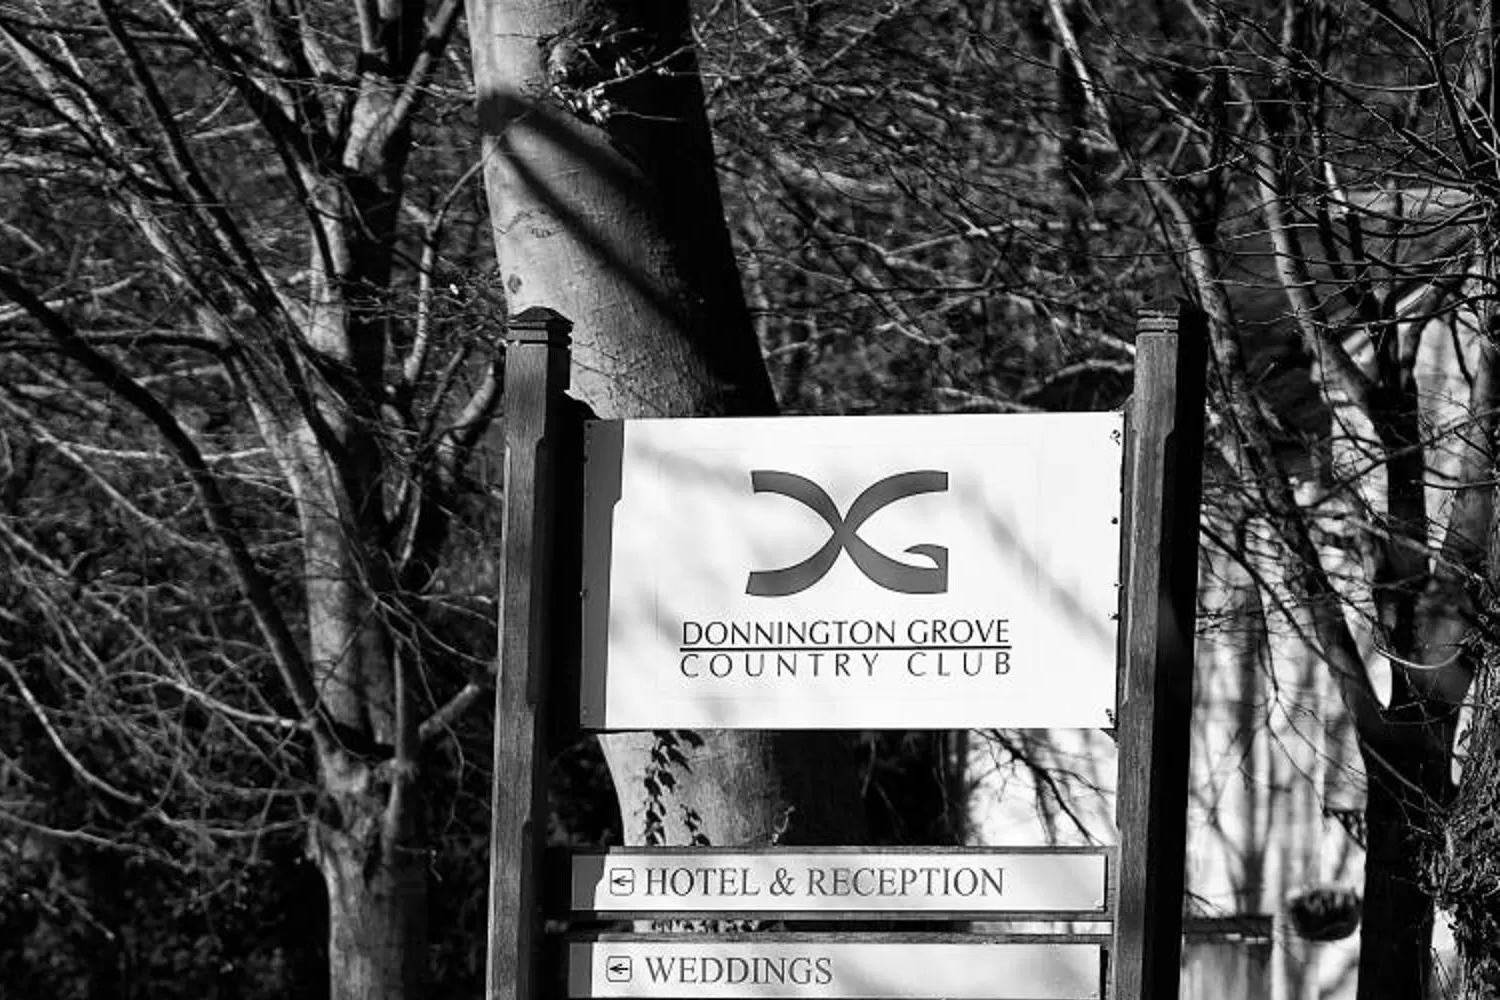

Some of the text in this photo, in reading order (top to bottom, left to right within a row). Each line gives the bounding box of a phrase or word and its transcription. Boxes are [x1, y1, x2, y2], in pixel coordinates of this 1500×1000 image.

[682, 618, 1010, 646] DONNINGTON GROVE
[680, 651, 1012, 678] COUNTRY CLUB
[643, 866, 1005, 897] HOTEL & RECEPTION
[644, 956, 834, 986] WEDDINGS
